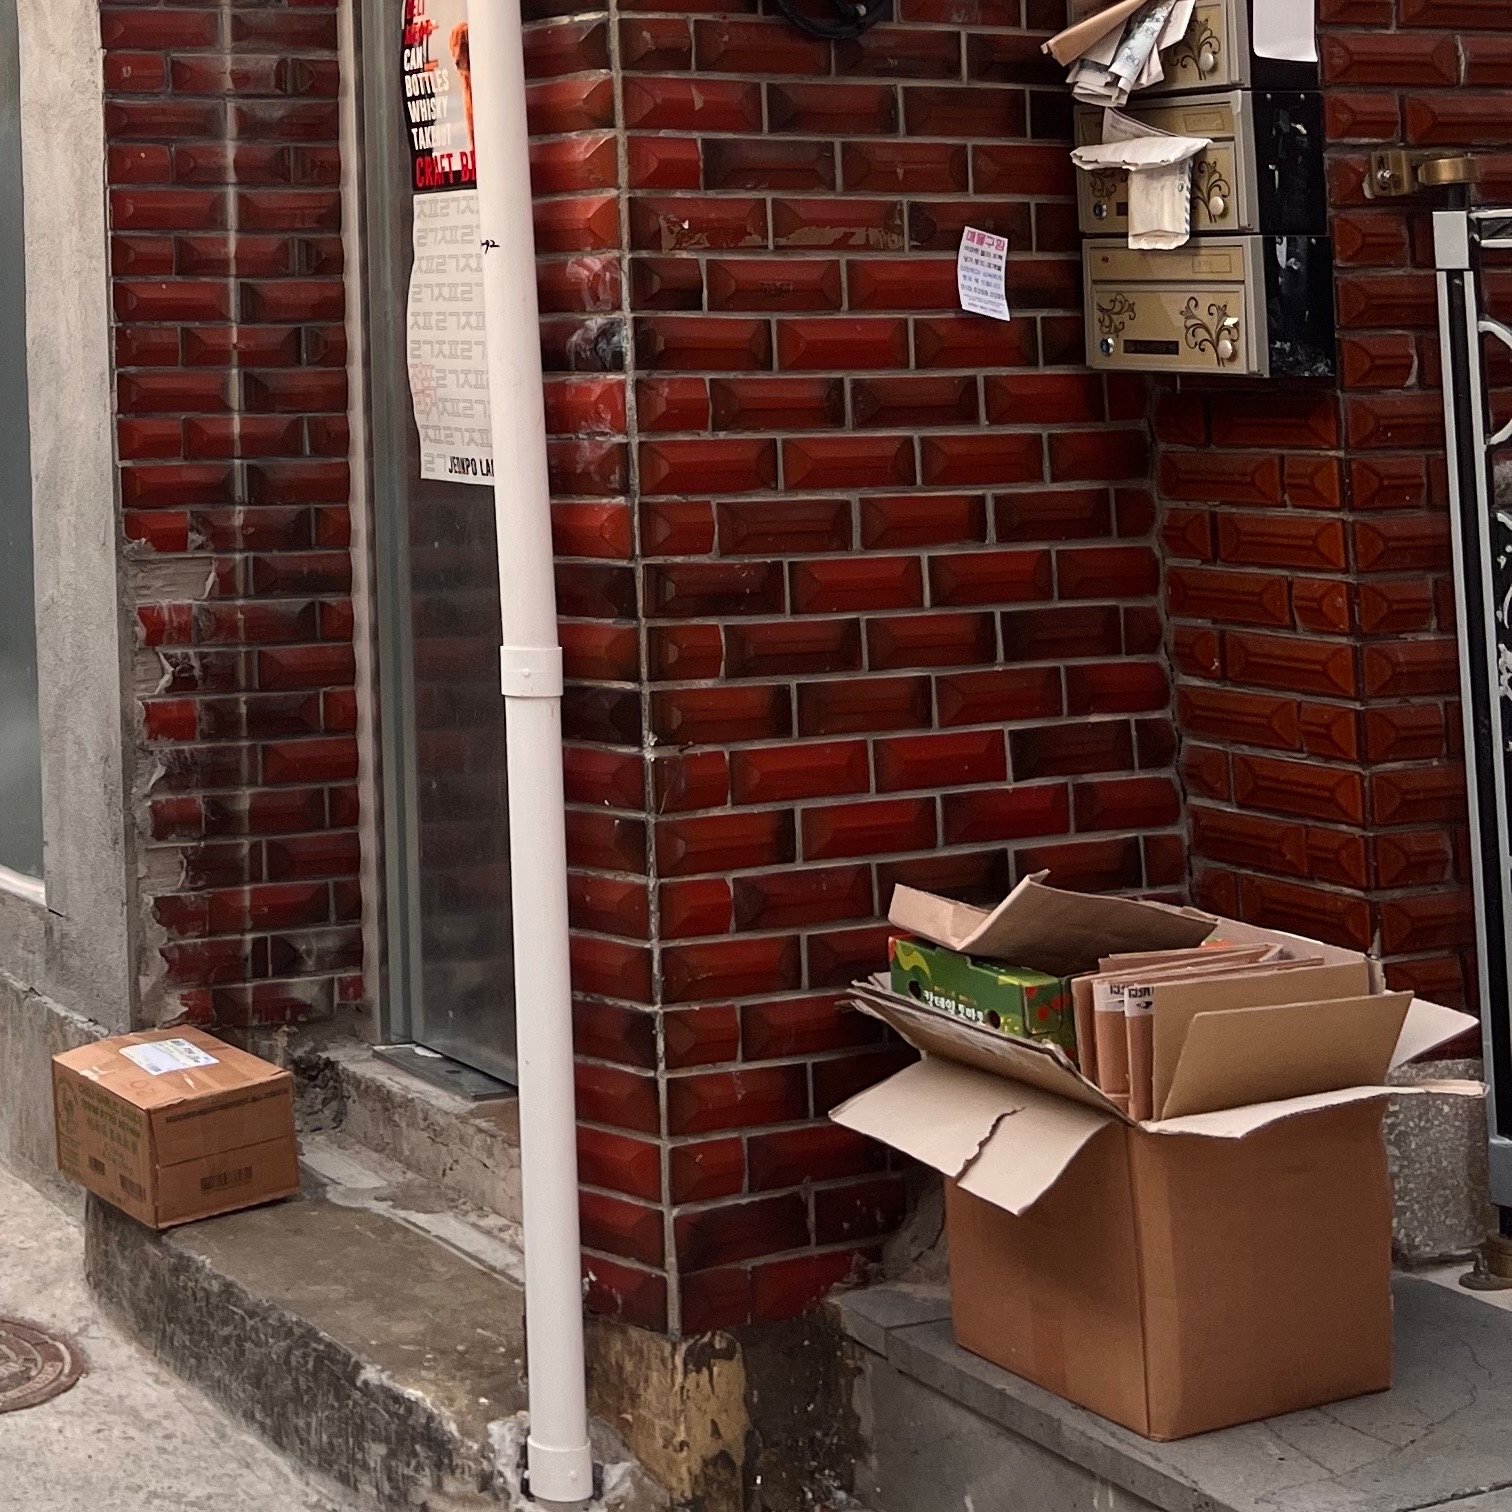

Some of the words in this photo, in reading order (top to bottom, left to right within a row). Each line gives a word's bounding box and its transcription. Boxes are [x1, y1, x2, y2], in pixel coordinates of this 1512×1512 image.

[403, 45, 424, 72] CAN
[404, 68, 449, 98] BOTTLES
[406, 95, 449, 123] WHISKY
[411, 122, 452, 151] TAKEOUT
[415, 152, 454, 188] CRAFT
